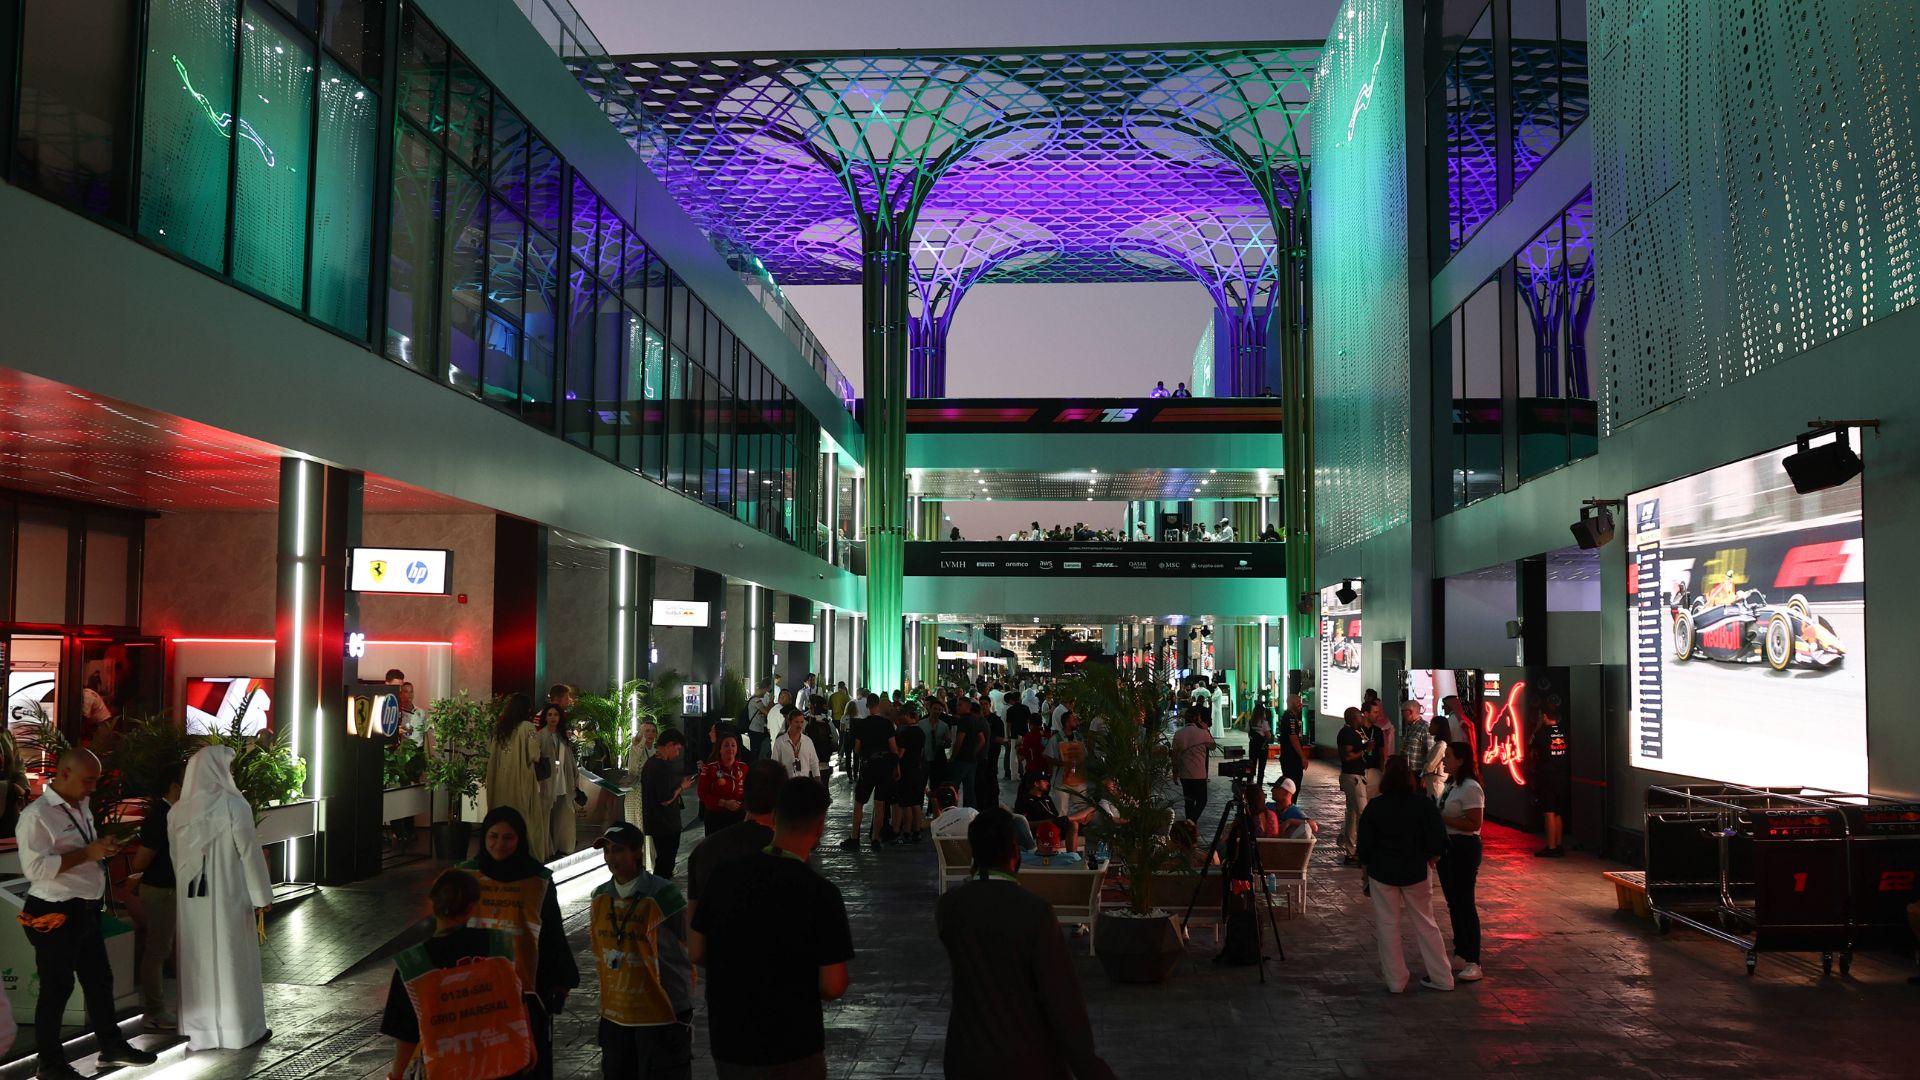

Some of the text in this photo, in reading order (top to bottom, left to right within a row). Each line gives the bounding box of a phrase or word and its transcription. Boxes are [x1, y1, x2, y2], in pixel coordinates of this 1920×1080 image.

[1101, 408, 1139, 422] 75
[406, 561, 428, 585] hp
[382, 695, 398, 736] hp
[1765, 809, 1826, 817] ORACLE
[1792, 872, 1808, 893] 1
[1877, 870, 1916, 892] 2
[430, 999, 509, 1026] GRID MARSHAL
[436, 1031, 479, 1057] PIT
